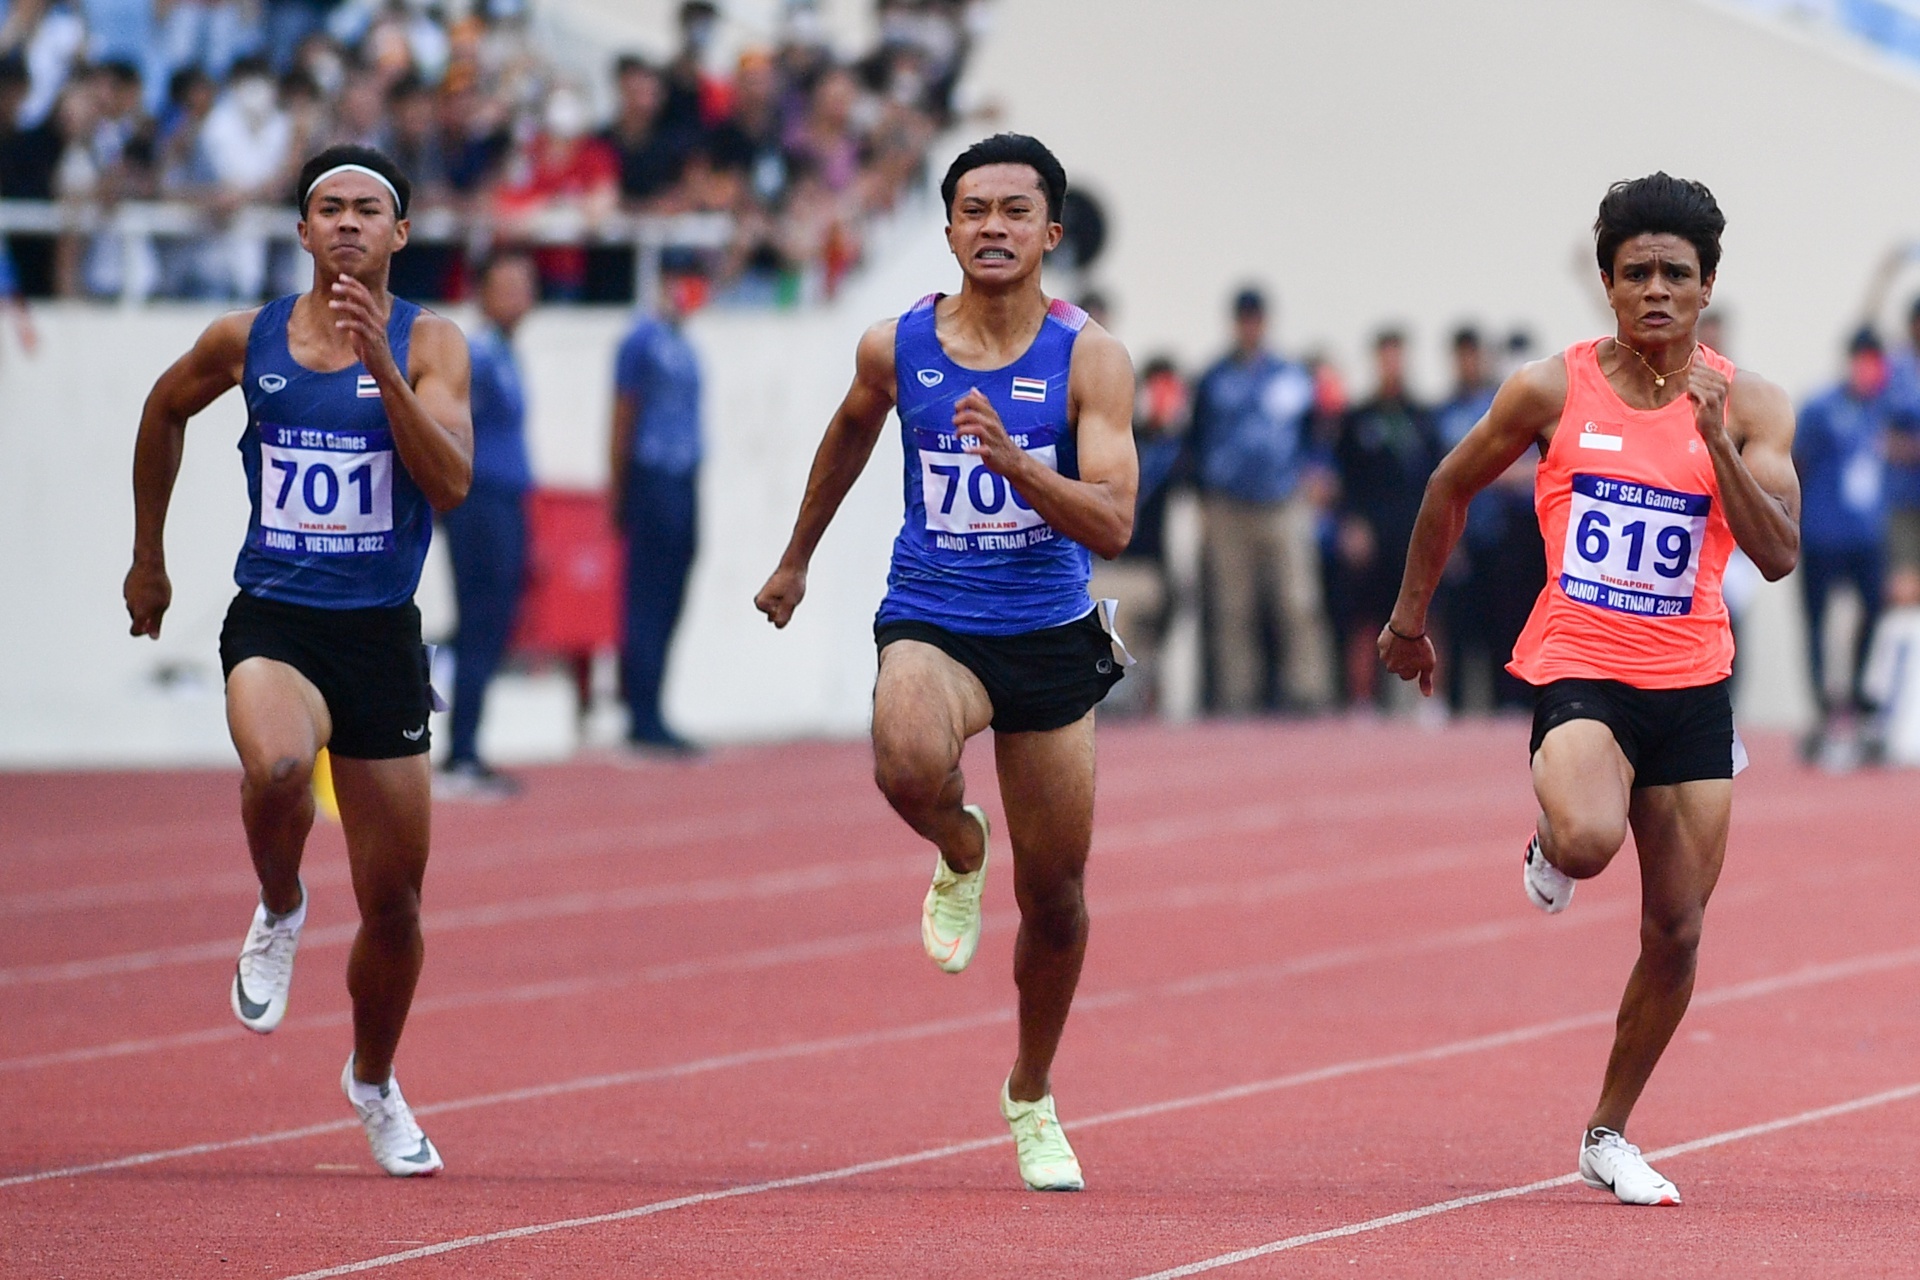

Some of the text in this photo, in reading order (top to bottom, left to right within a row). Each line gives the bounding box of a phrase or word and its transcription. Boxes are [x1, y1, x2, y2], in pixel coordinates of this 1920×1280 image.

[300, 430, 324, 448] SEA
[326, 433, 367, 450] Games
[271, 457, 372, 515] 701
[1619, 485, 1642, 504] SEA
[1645, 490, 1687, 512] Games
[299, 522, 347, 531] THAILAND
[968, 521, 1017, 530] THAILAND
[265, 530, 296, 551] HANOI
[304, 536, 355, 553] VIETNAM
[357, 535, 384, 552] 2022
[936, 534, 968, 551] HANOI
[977, 534, 1027, 551] VIETNAM
[1028, 526, 1054, 545] 2022
[1576, 510, 1691, 579] 619
[1600, 574, 1655, 591] SINGAPORE
[1565, 580, 1599, 602] HANOI
[1608, 590, 1656, 614] VIETNAM
[1656, 600, 1683, 616] 2022
